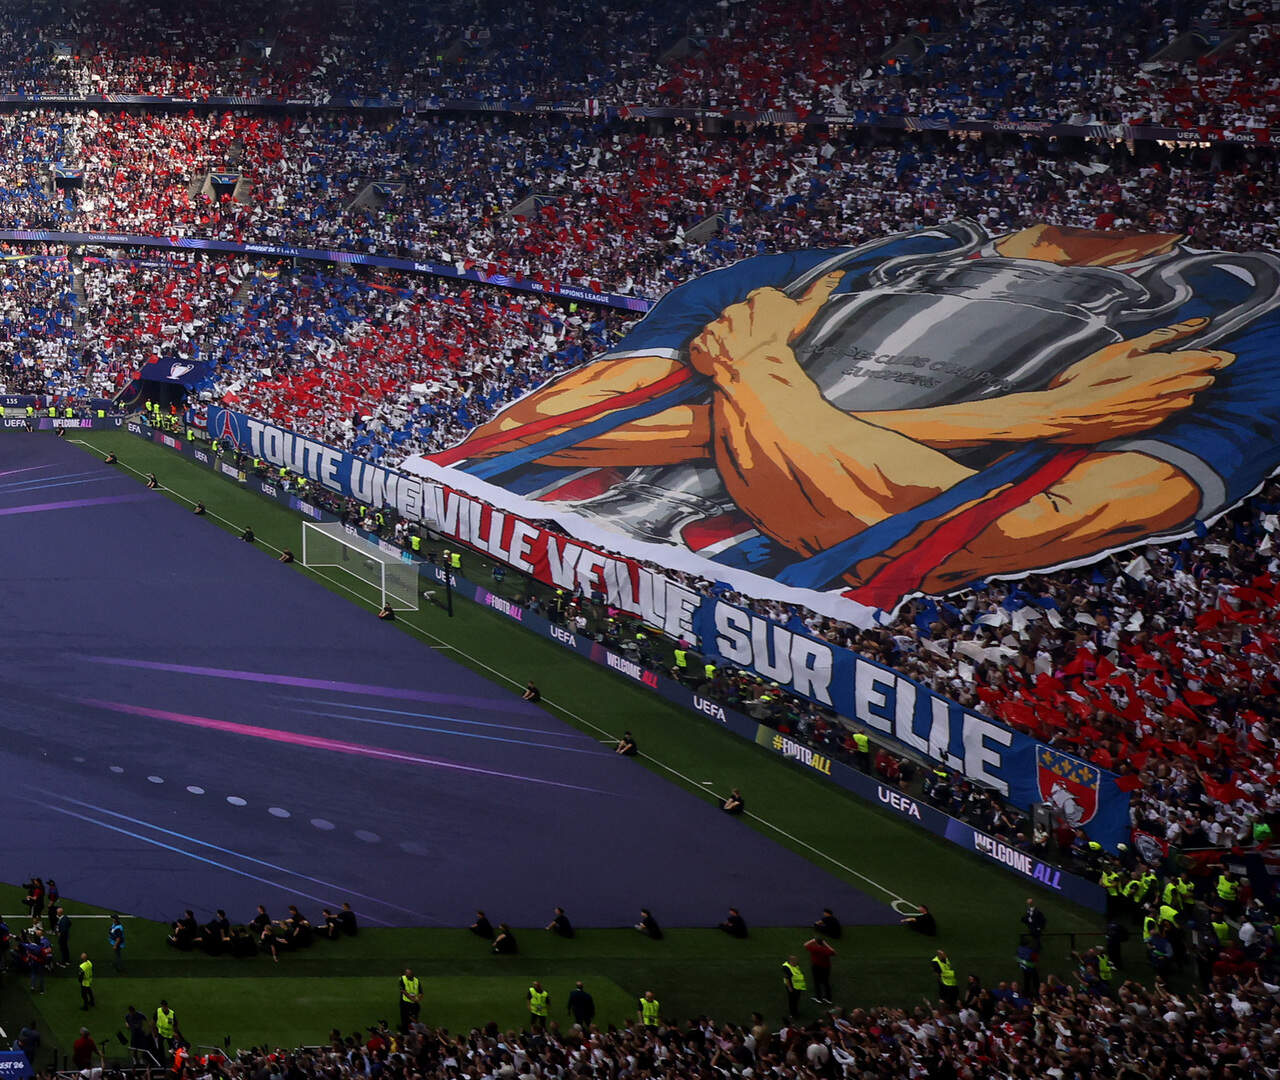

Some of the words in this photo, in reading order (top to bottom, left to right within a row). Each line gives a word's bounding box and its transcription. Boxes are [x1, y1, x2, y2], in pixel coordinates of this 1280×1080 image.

[1177, 132, 1201, 140] UEFA
[584, 292, 609, 303] LEAGUE
[4, 419, 27, 428] UEFA
[53, 419, 80, 428] WELCOME
[80, 419, 92, 428] ALL
[194, 450, 209, 463] UEFA
[261, 483, 277, 498] UEFA
[435, 568, 456, 587] UEA
[247, 419, 343, 492] TOUTE
[350, 458, 422, 520] UNE
[434, 486, 540, 575] VILLE
[547, 535, 702, 647] VEILLE
[714, 600, 833, 706] SUR
[855, 659, 1012, 798] ELLE
[484, 593, 523, 621] #FOOTBALL
[550, 626, 577, 648] UEFA
[606, 651, 641, 681] WELCOME
[640, 669, 658, 689] ALL
[693, 694, 727, 722] UEFA
[772, 733, 832, 776] #FOOTBALL
[877, 785, 921, 821] UEFA
[974, 830, 1033, 876] WELCOME
[1032, 862, 1063, 891] ALL
